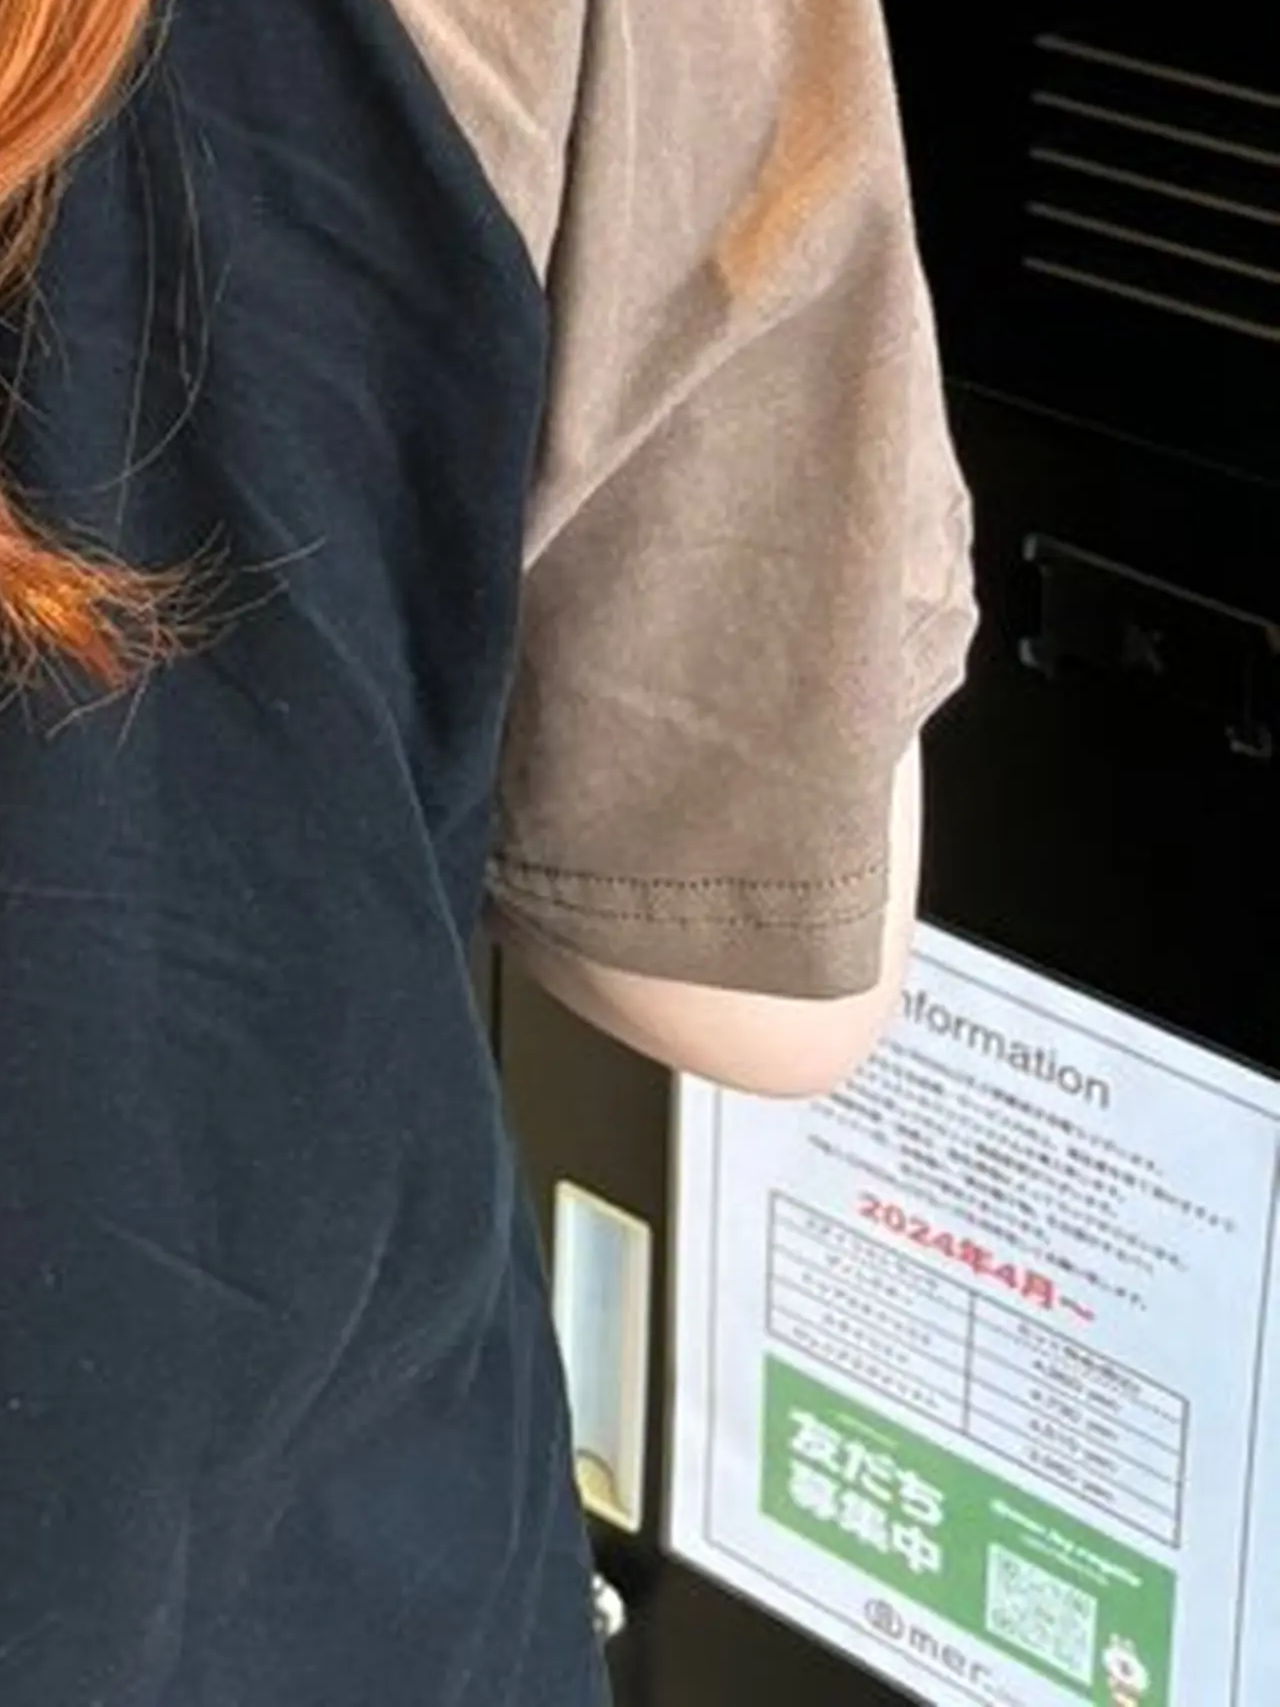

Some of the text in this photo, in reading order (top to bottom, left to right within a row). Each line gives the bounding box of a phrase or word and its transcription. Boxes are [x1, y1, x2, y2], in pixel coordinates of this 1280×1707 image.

[788, 1457, 943, 1575] 募集中
[790, 1408, 944, 1527] 友だち
[908, 1624, 993, 1683] mer
